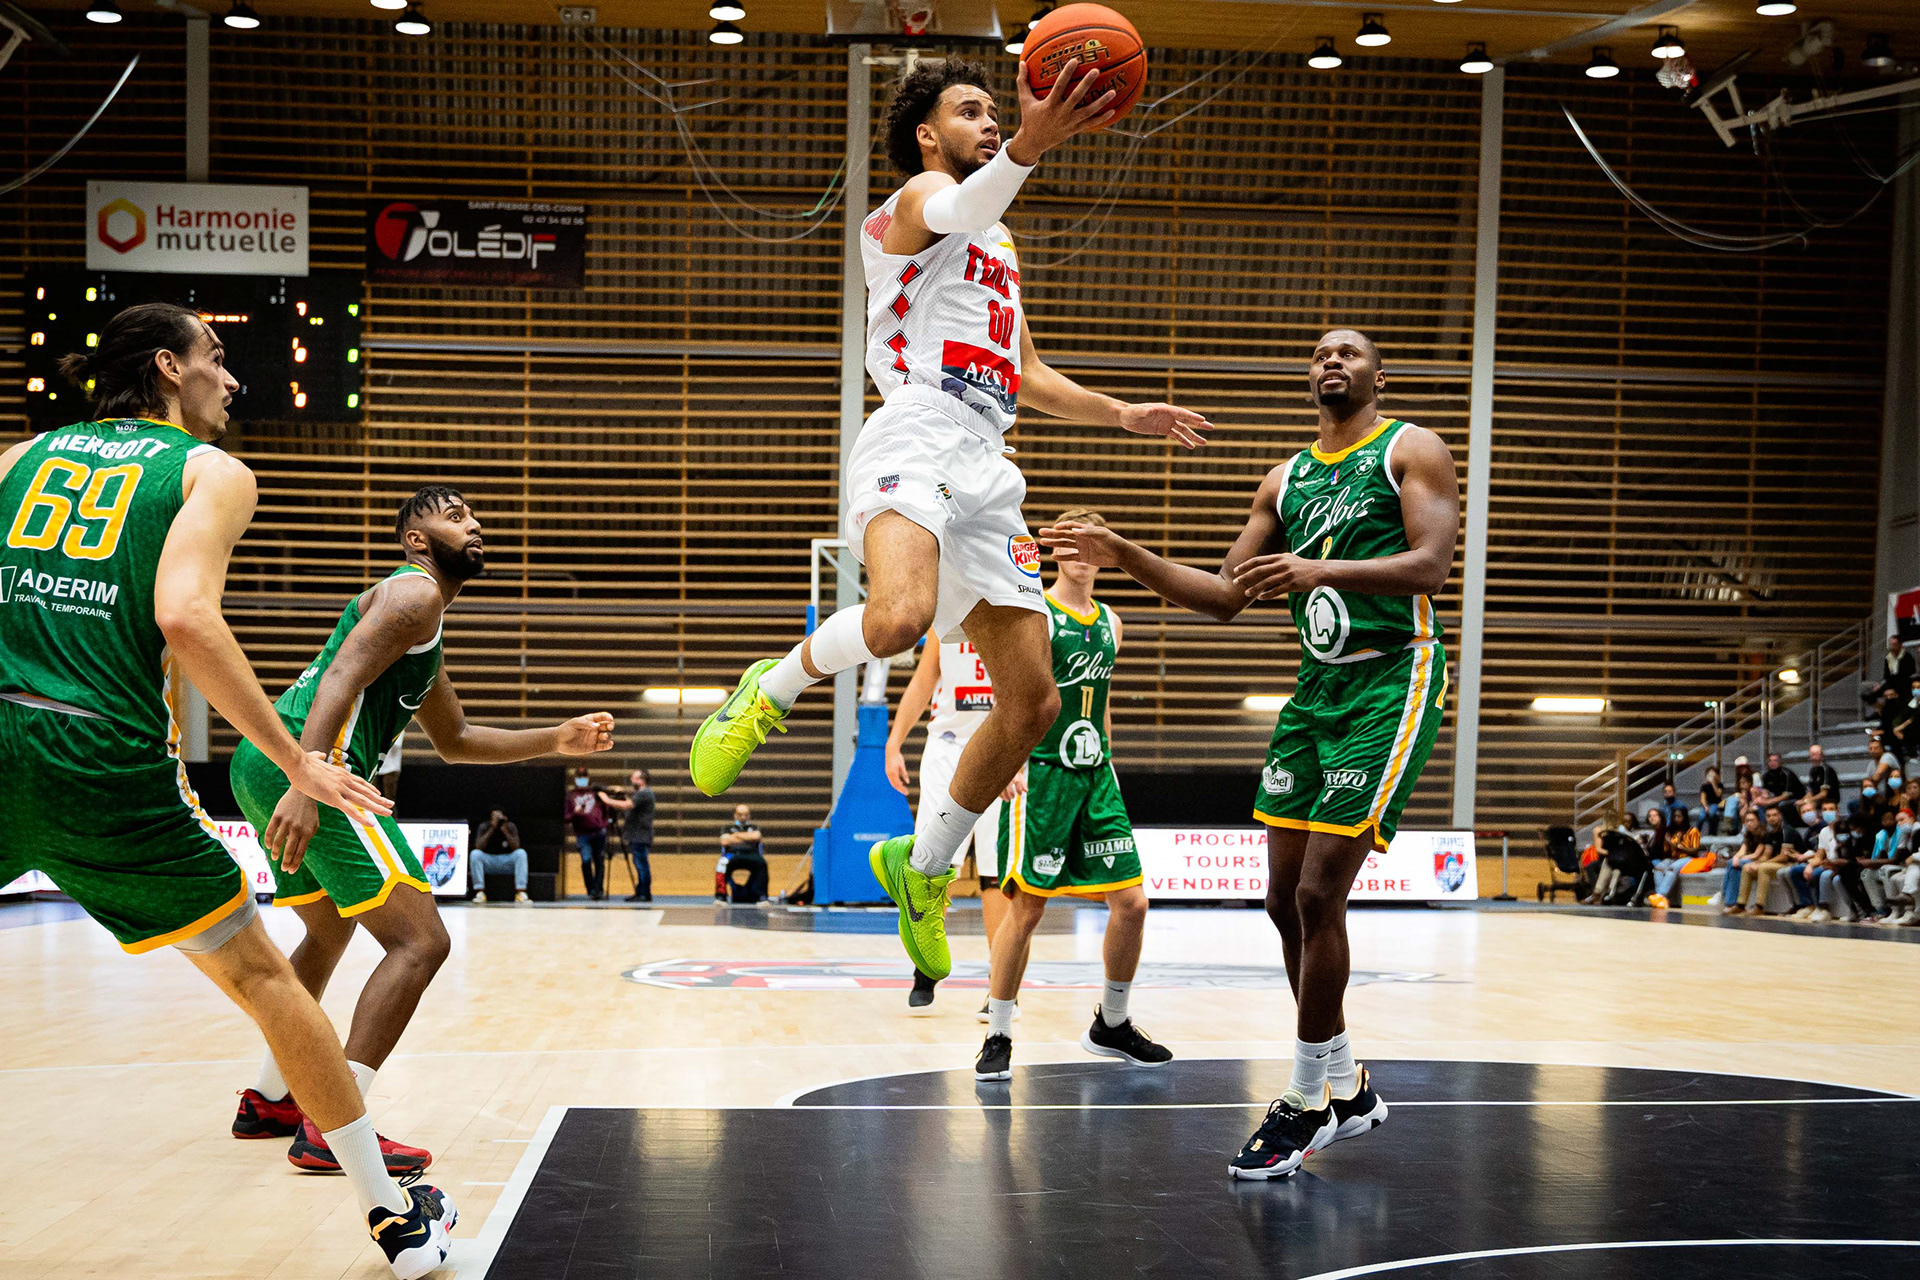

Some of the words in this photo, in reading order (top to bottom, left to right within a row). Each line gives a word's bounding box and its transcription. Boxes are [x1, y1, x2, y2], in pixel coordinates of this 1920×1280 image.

[157, 204, 297, 231] Harmonie
[157, 231, 297, 253] mutuelle
[48, 434, 170, 459] HERGOTT
[7, 456, 144, 561] 69
[1292, 486, 1375, 555] Blois
[1015, 551, 1041, 566] KING
[17, 568, 119, 606] ADERIM
[14, 594, 48, 610] TRAVAIL
[51, 602, 112, 621] TEMPORAIRE
[1084, 839, 1134, 856] SIDAMO
[1182, 855, 1261, 868] TOURS
